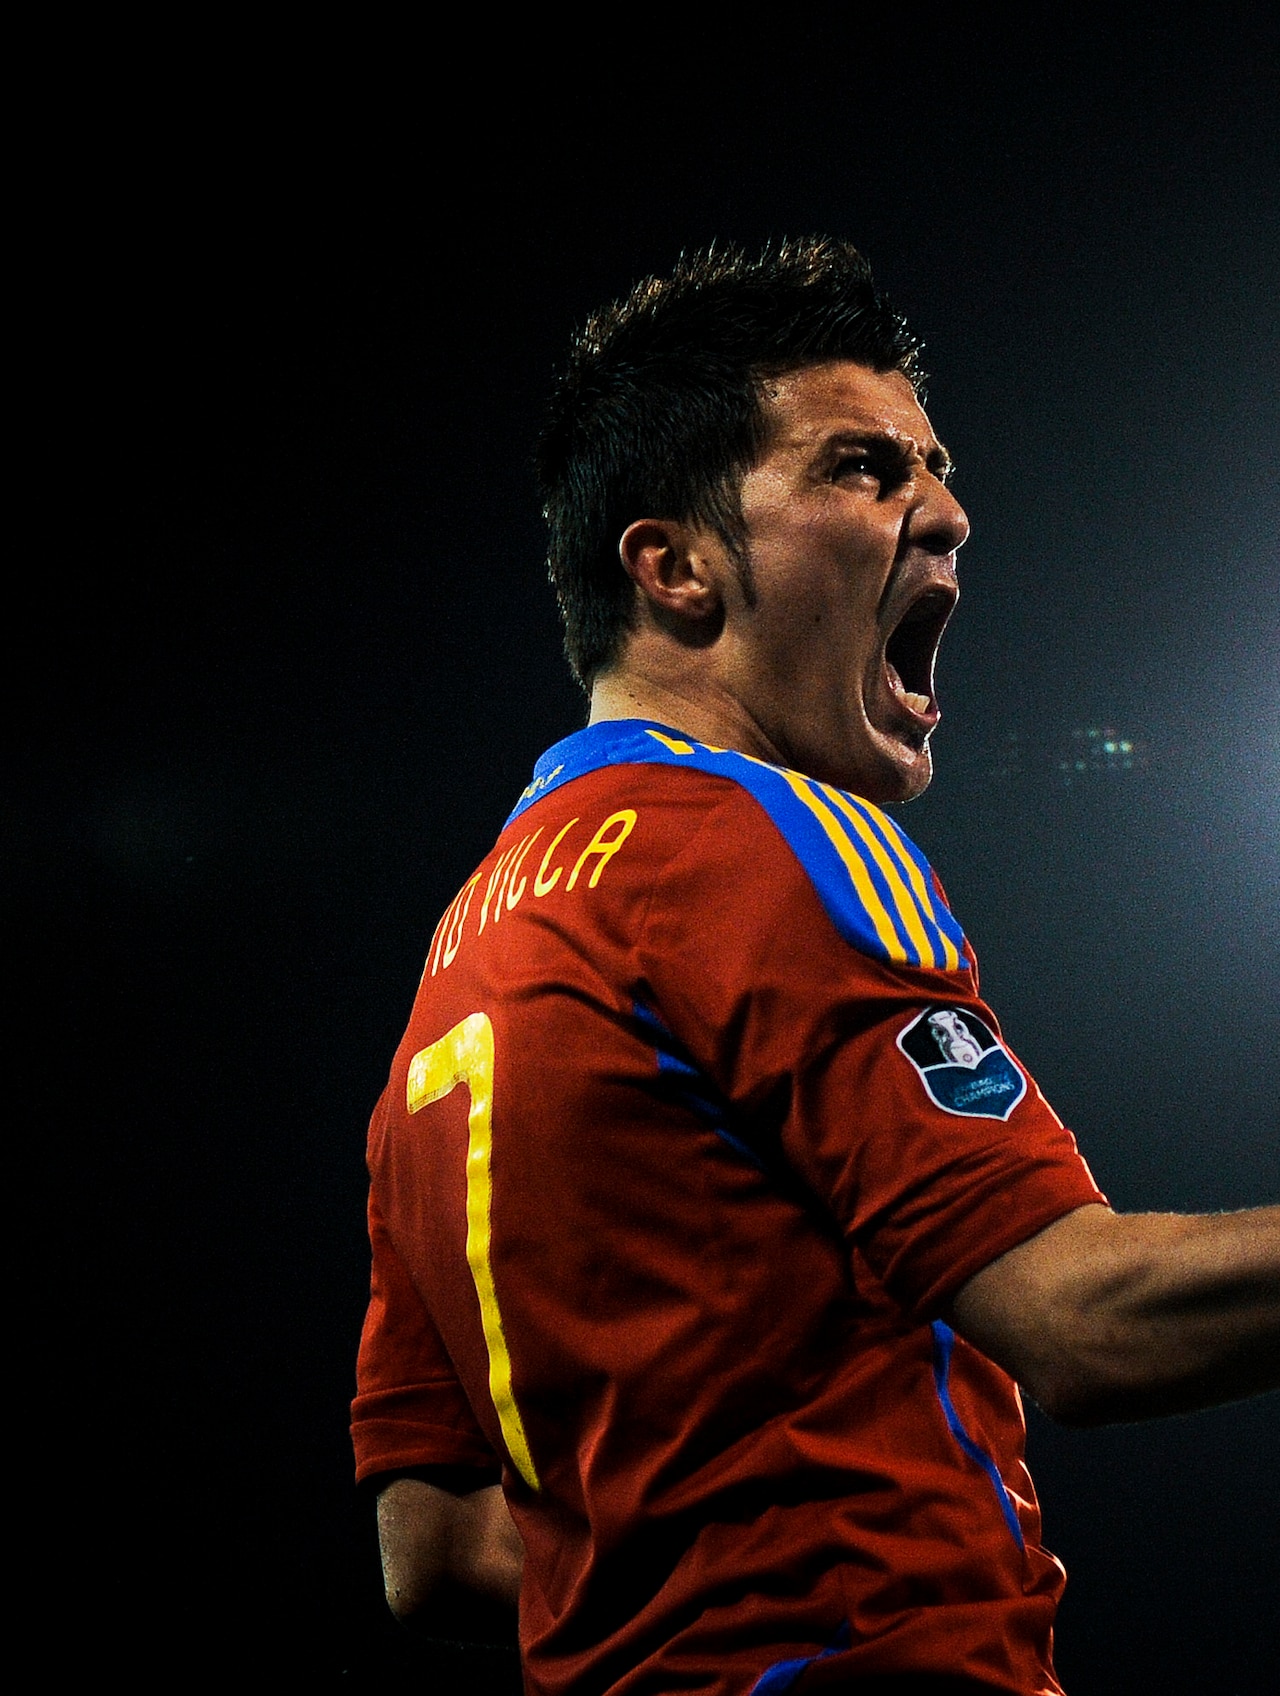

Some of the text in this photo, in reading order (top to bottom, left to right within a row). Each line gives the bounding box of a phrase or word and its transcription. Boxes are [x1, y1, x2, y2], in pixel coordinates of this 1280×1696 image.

[477, 808, 638, 936] VILLA
[954, 1082, 1014, 1106] CHAMPIONS
[406, 1011, 542, 1493] 7
